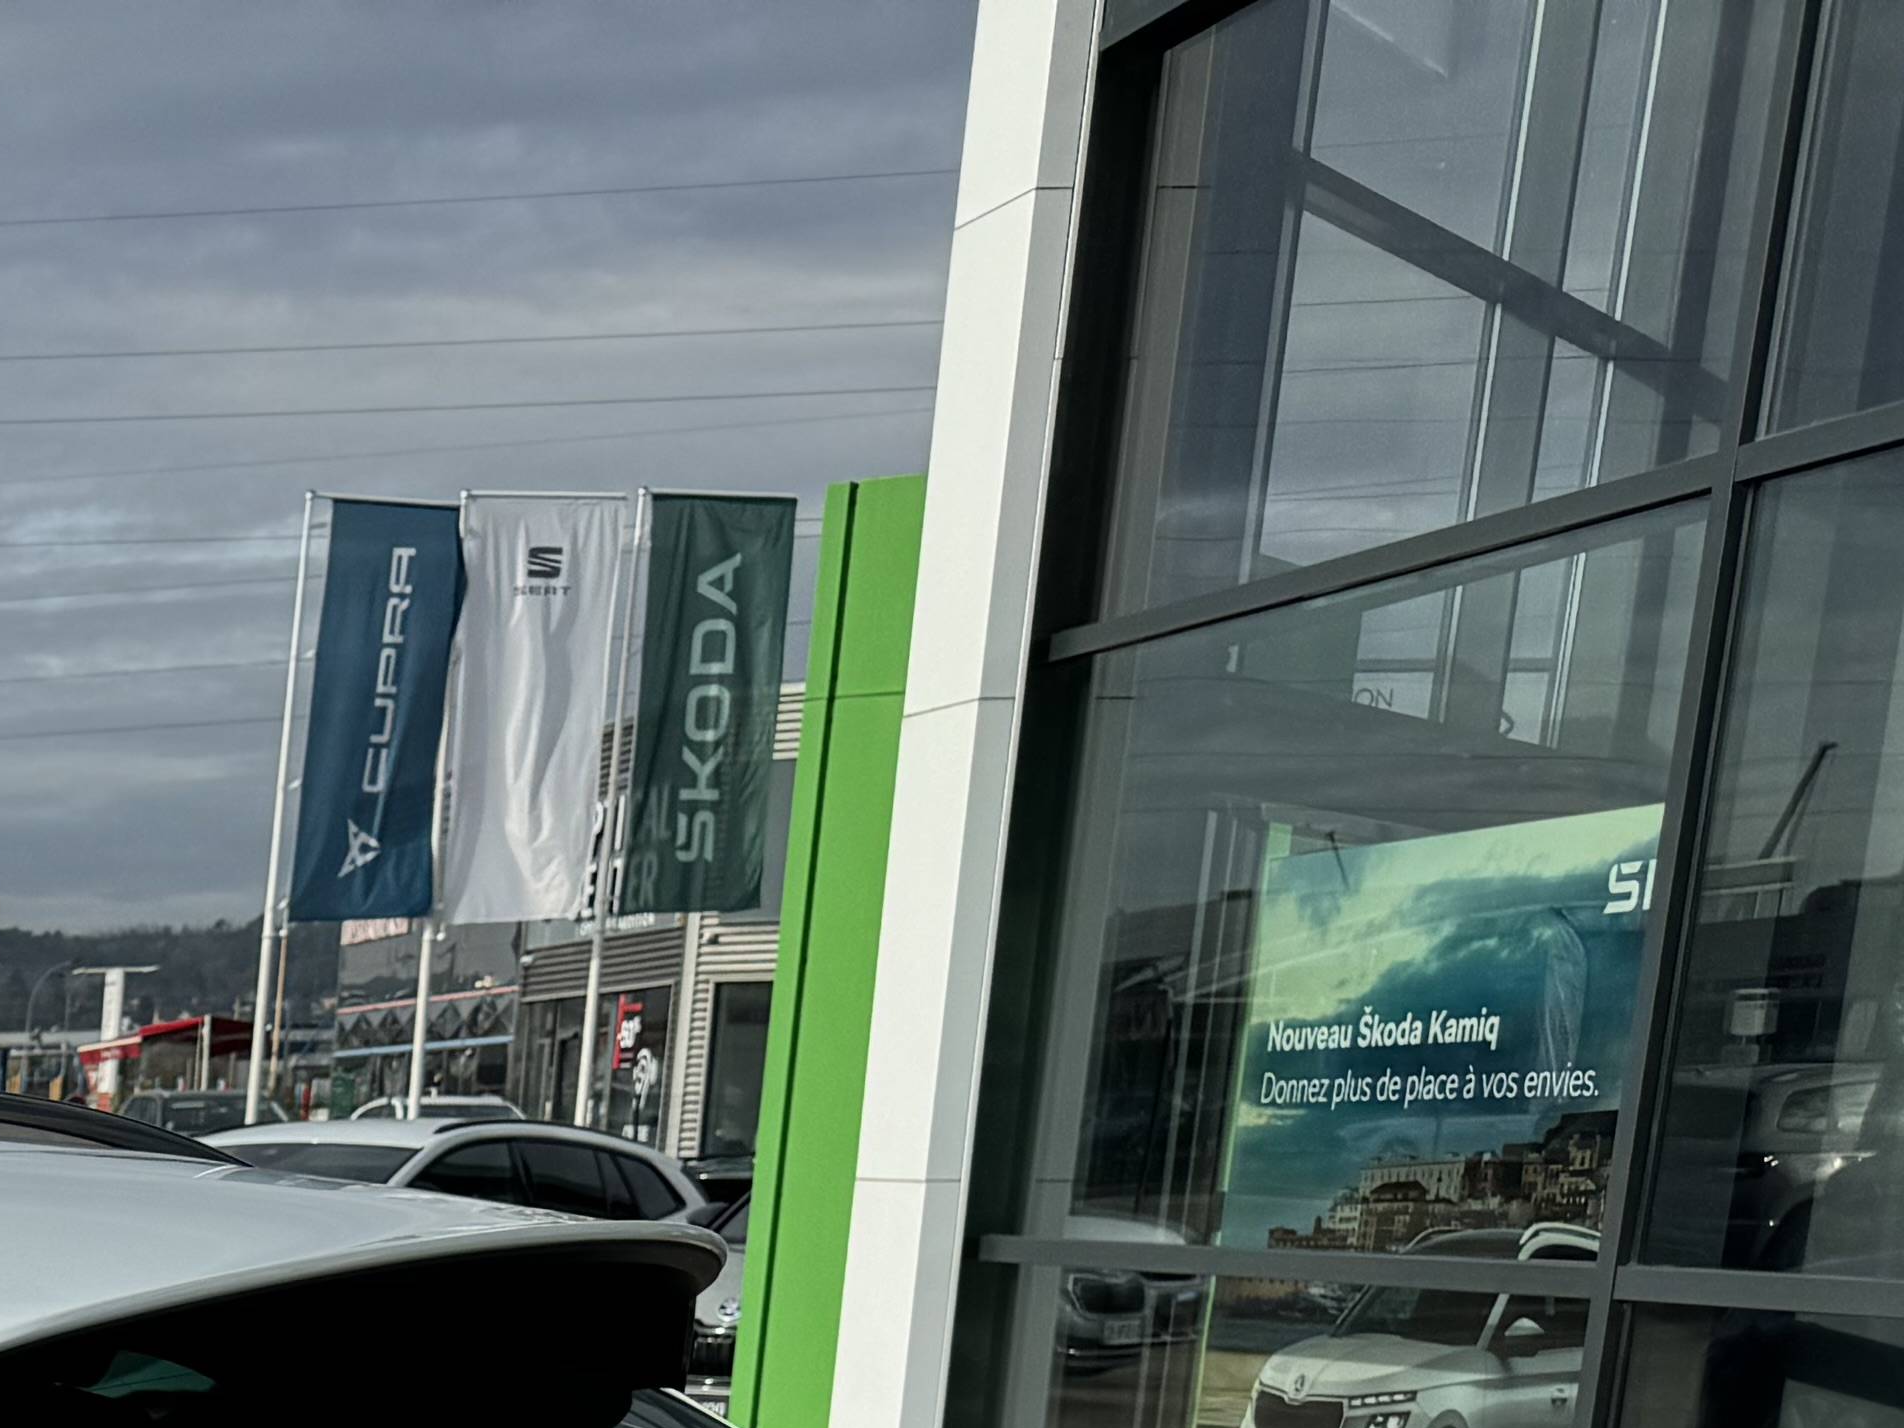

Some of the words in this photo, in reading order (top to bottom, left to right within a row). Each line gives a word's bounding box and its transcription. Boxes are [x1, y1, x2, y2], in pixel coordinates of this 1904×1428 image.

[513, 585, 571, 597] SEAT
[362, 547, 416, 793] CUPRA
[1267, 1019, 1353, 1051] Nouveau
[1357, 1006, 1423, 1049] Škoda
[1427, 1007, 1501, 1050] Kamiq
[1260, 1071, 1328, 1104] Donnez
[1330, 1069, 1371, 1110] plus
[1376, 1067, 1400, 1101] de
[1404, 1071, 1459, 1109] place
[1463, 1065, 1476, 1099] à
[1482, 1069, 1518, 1098] vos
[1523, 1062, 1600, 1098] envies.
